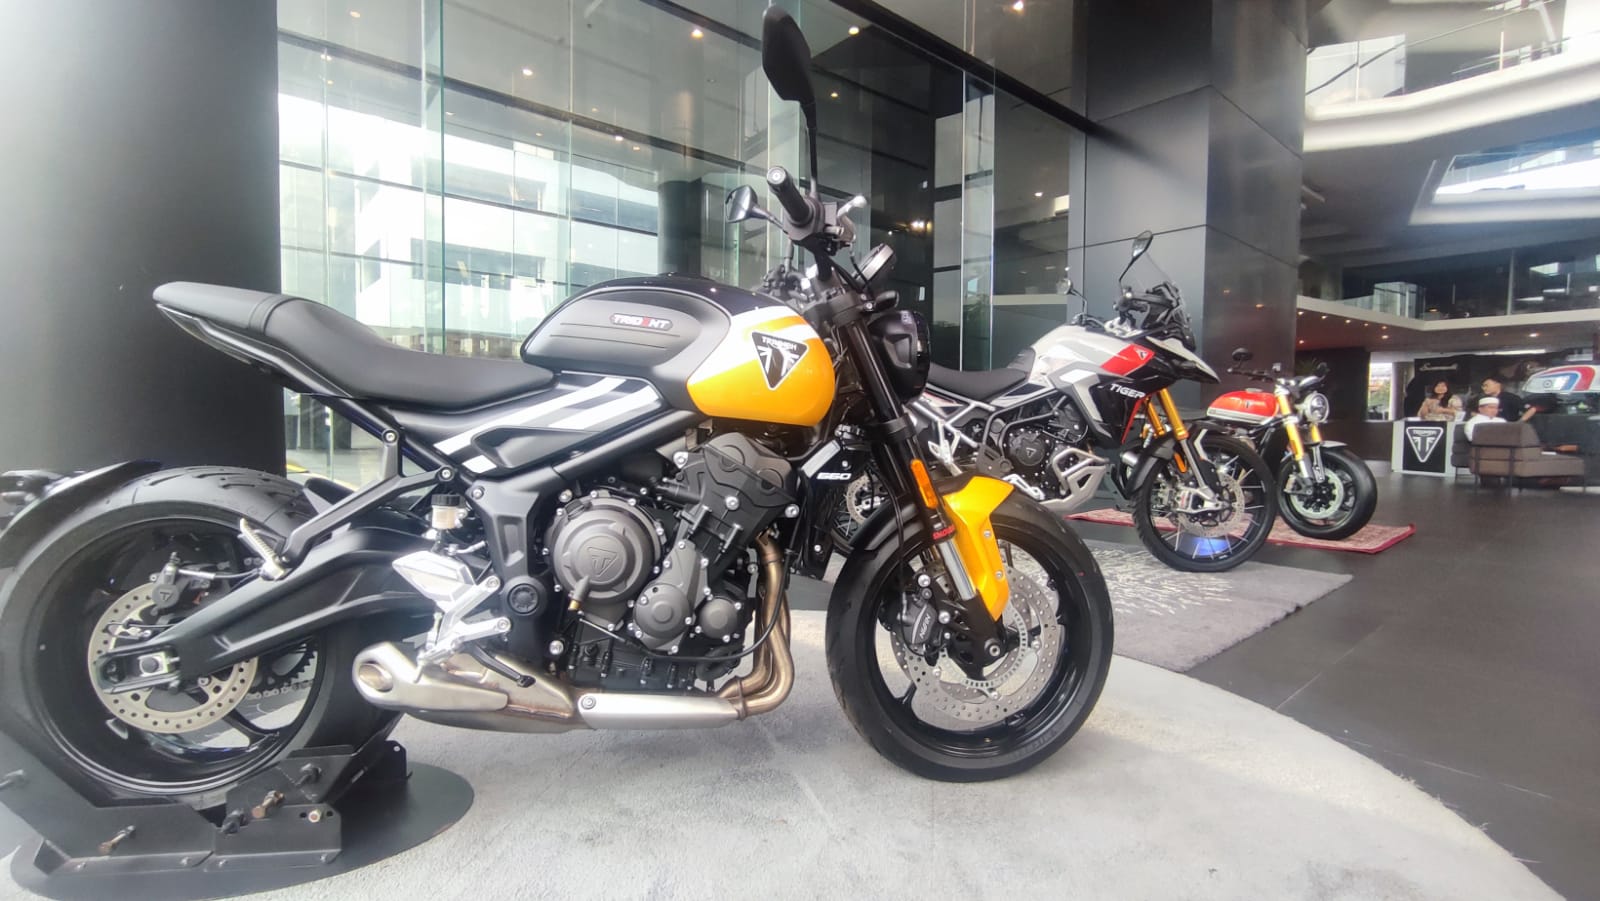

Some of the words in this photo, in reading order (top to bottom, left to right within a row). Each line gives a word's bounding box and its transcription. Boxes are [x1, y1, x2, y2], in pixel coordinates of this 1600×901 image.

[614, 314, 671, 329] TRIDENT
[1110, 383, 1146, 399] TIGER
[816, 472, 852, 480] 660
